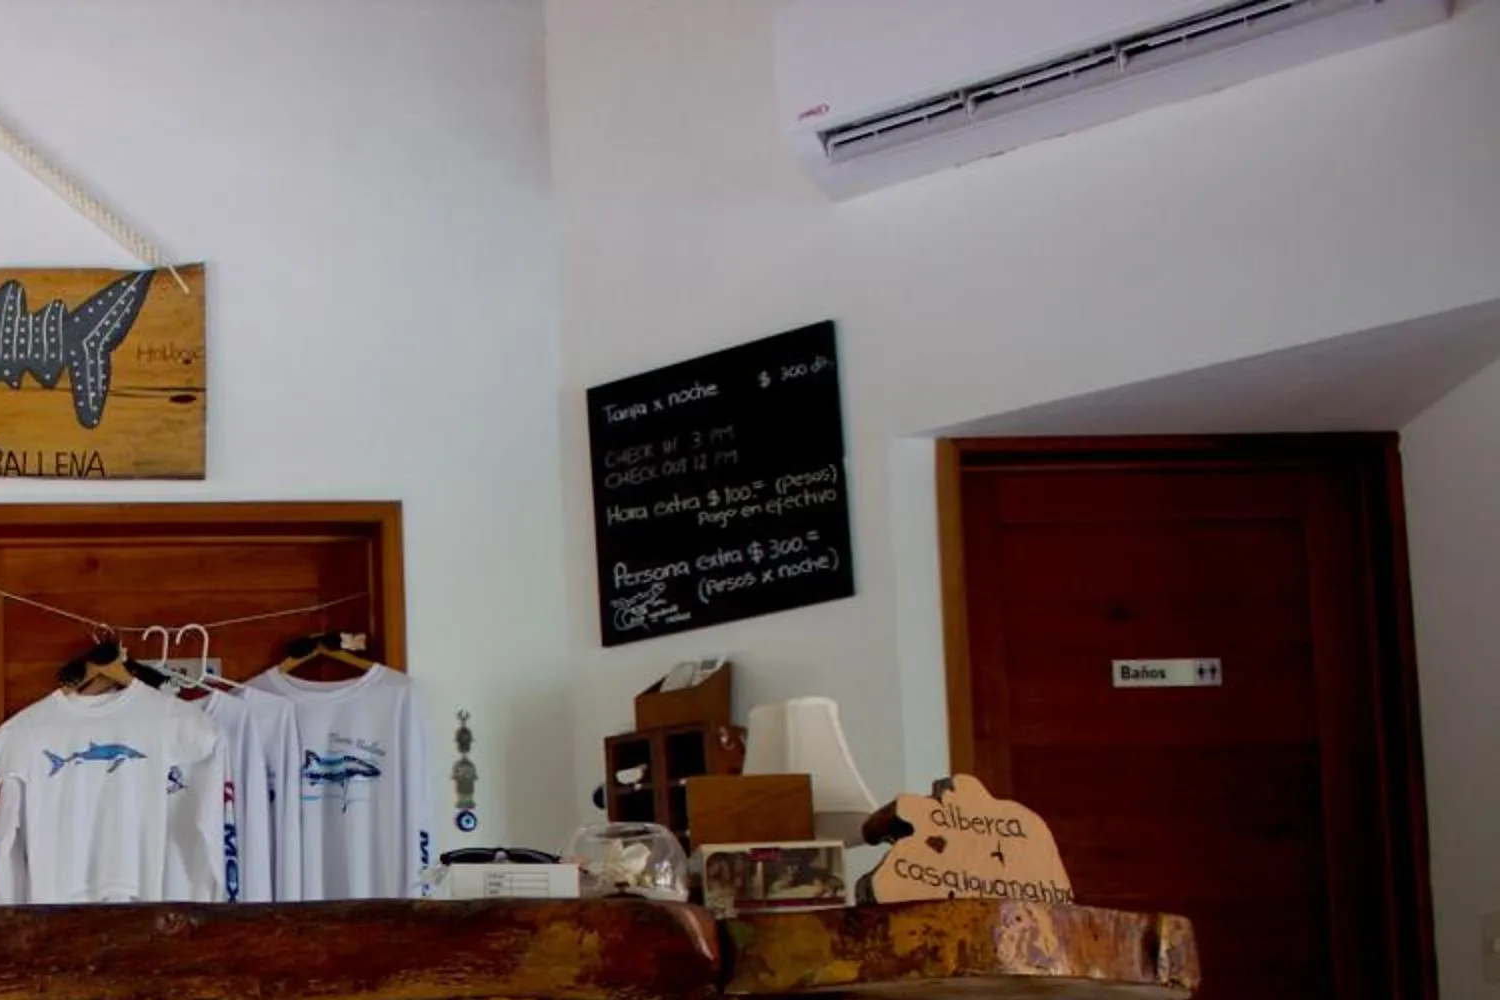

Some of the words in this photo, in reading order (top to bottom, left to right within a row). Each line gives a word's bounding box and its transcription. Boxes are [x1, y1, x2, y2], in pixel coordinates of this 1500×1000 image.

[668, 381, 719, 407] noche
[757, 370, 771, 388] $
[653, 494, 700, 517] extra
[707, 490, 721, 506] $
[740, 503, 763, 518] en
[765, 488, 837, 516] efectivo
[613, 561, 690, 589] Persona
[695, 549, 743, 571] extra
[747, 540, 764, 564] $
[761, 567, 775, 584] x
[1120, 664, 1168, 680] Baños
[930, 803, 1027, 840] alberca
